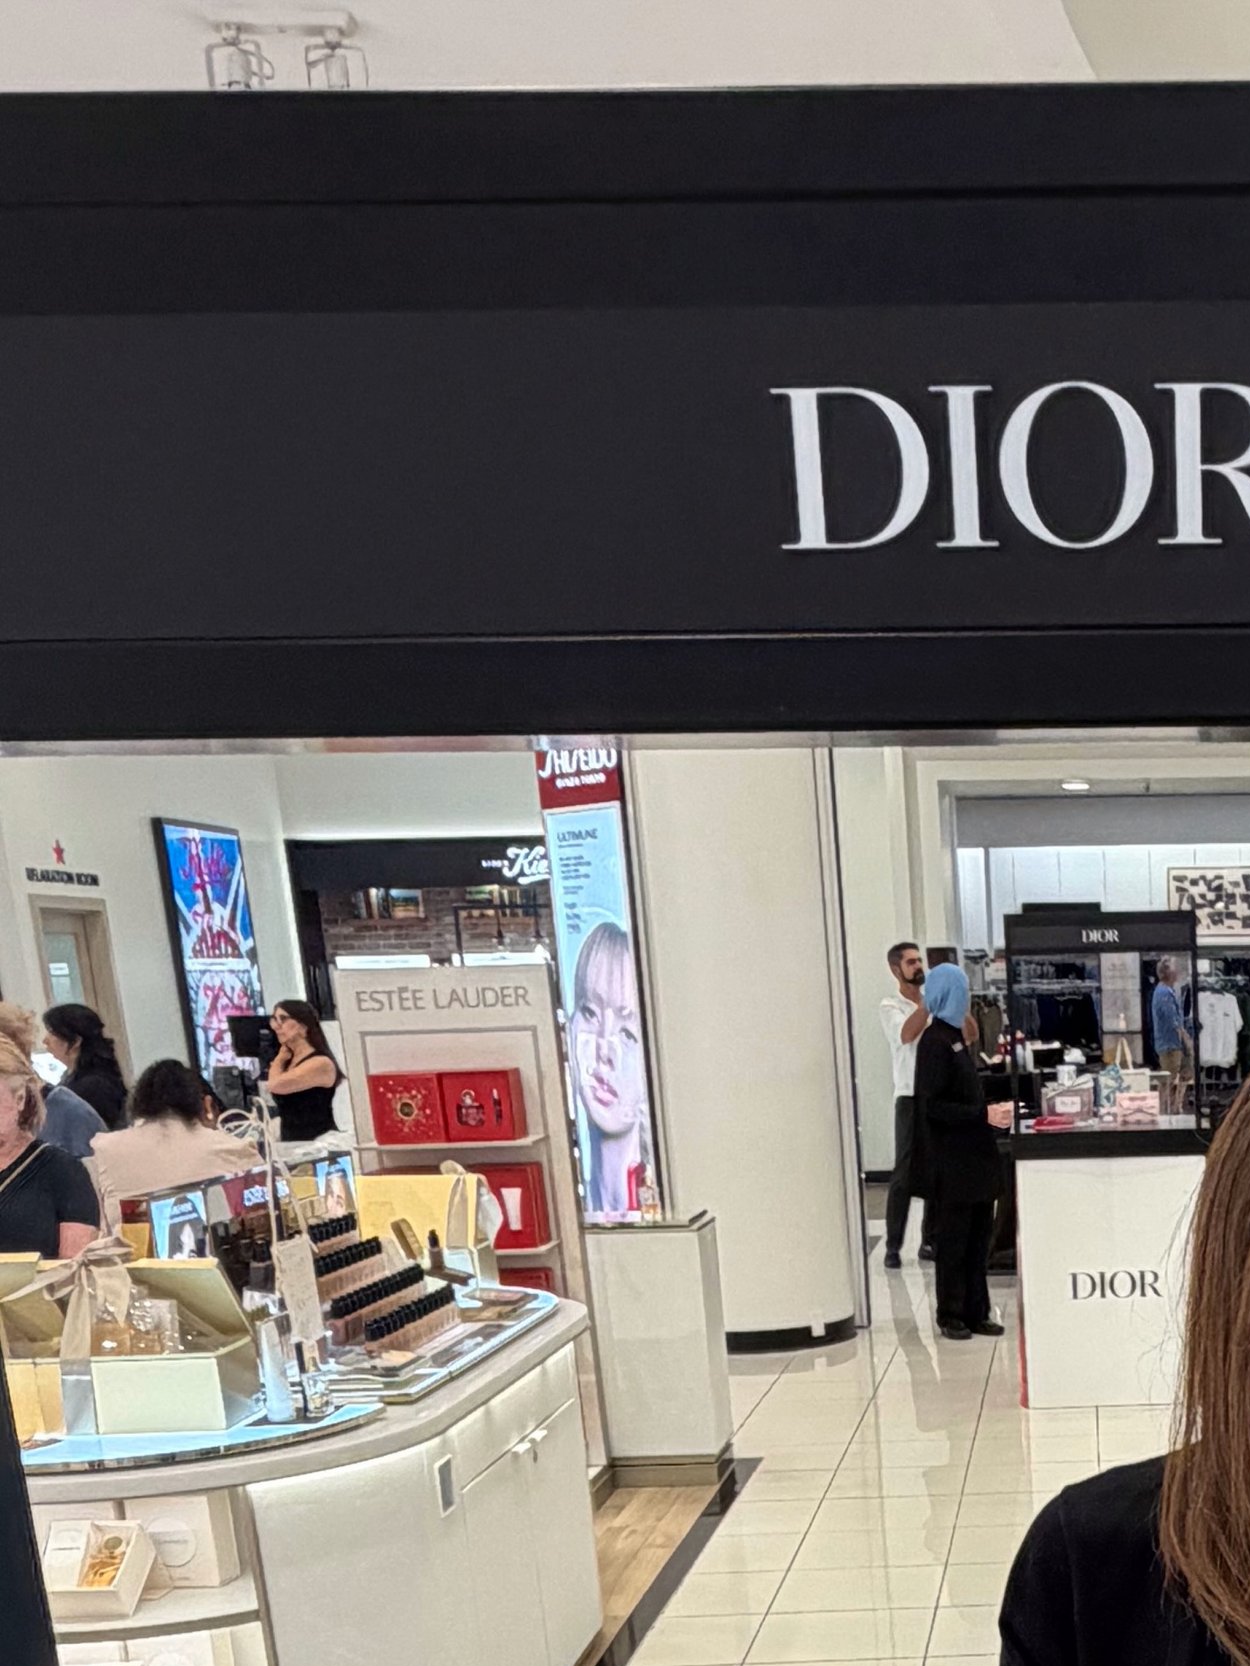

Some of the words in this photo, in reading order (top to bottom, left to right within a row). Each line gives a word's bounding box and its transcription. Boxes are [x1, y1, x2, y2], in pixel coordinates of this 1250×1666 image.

[1081, 928, 1120, 943] DIOR
[432, 986, 532, 1010] LAUDER
[1068, 1269, 1164, 1300] DIOR
